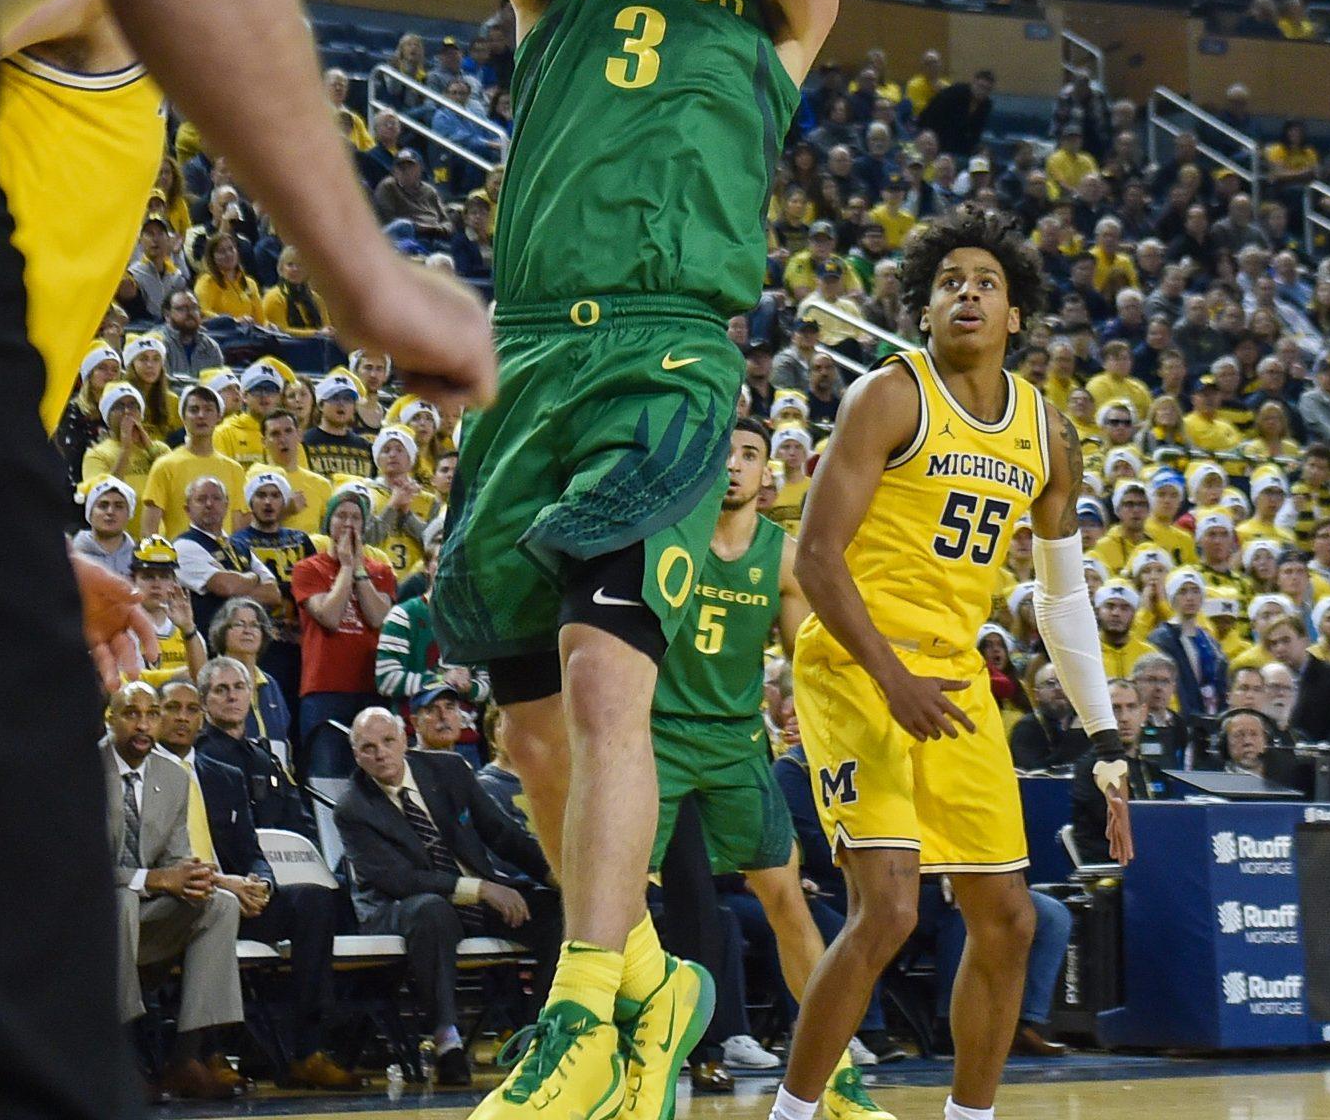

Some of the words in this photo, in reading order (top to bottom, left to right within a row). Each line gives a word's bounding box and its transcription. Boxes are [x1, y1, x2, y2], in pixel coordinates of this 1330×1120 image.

[605, 6, 667, 89] 3
[571, 300, 600, 327] O
[925, 453, 1035, 497] MICHIGAN
[933, 491, 1011, 565] 55
[390, 543, 407, 570] 3
[657, 545, 694, 608] O
[694, 604, 727, 655] 5
[818, 760, 857, 807] M
[1237, 835, 1292, 859] Ruoff
[1239, 862, 1293, 875] MORTGAGE
[1243, 904, 1298, 928] Ruoff
[1244, 931, 1298, 944] MORTGAGE
[1248, 975, 1303, 999] Ruoff
[1249, 1002, 1303, 1016] MORTGAGE
